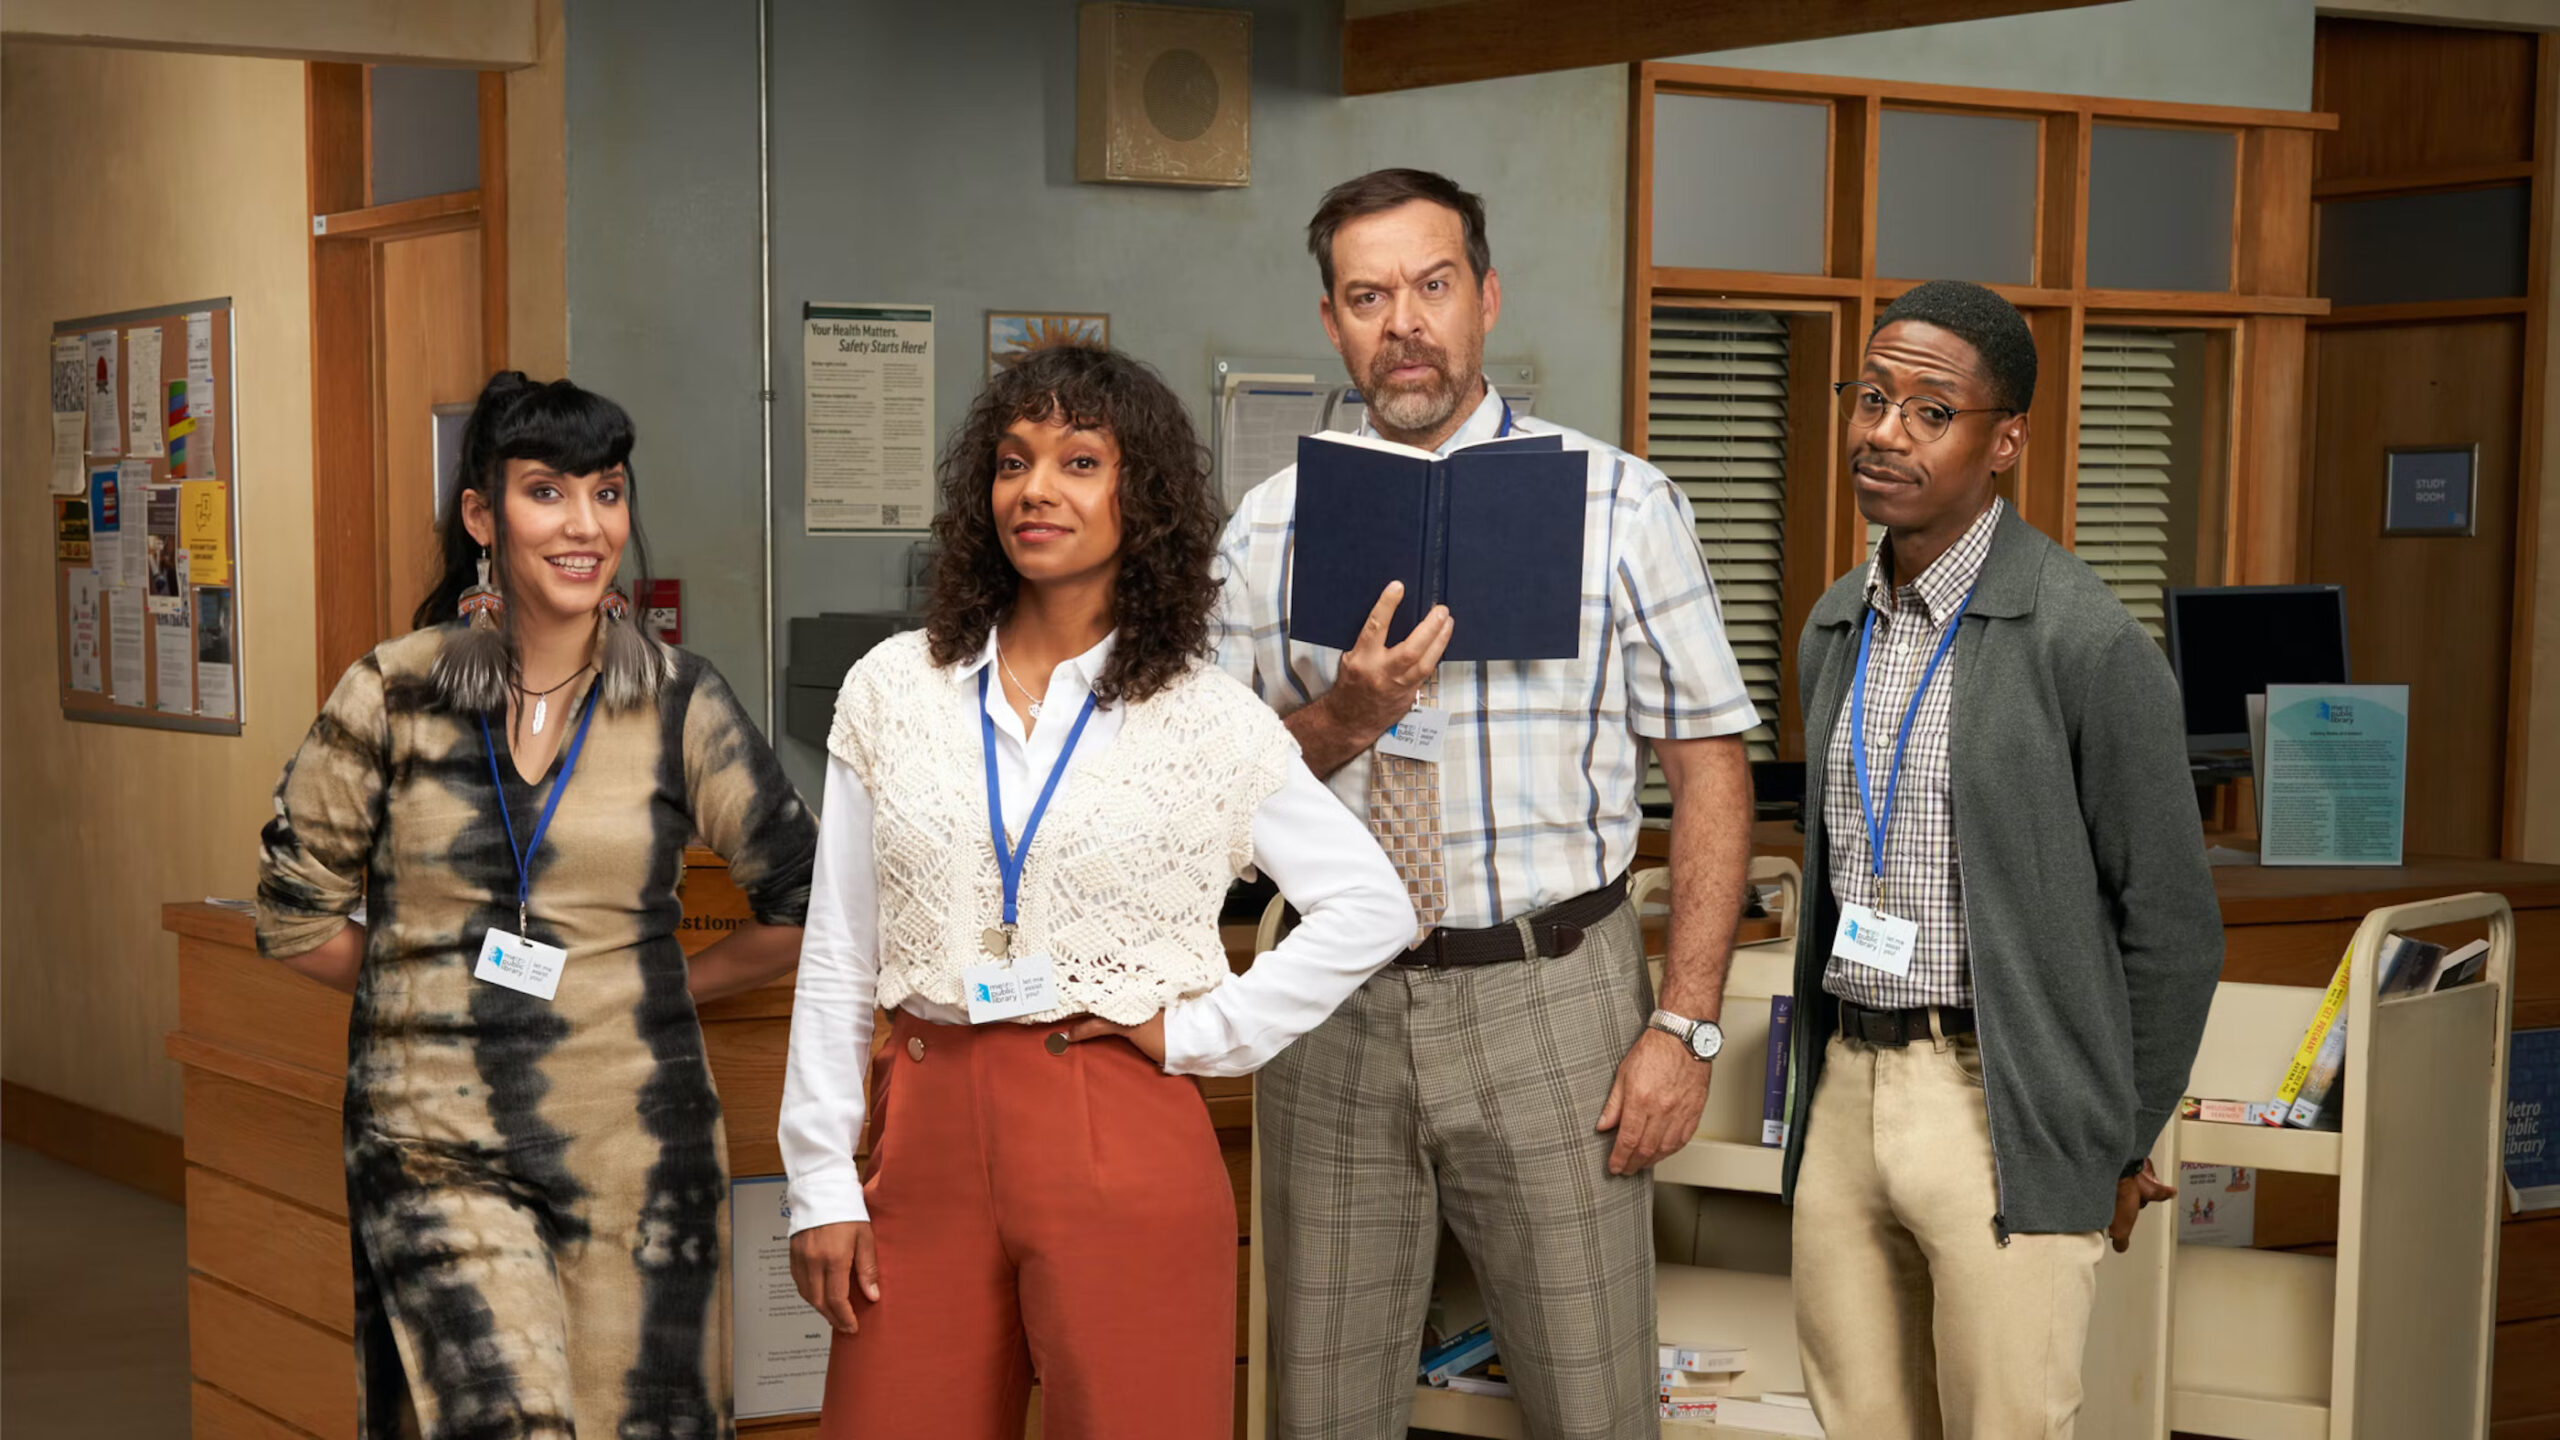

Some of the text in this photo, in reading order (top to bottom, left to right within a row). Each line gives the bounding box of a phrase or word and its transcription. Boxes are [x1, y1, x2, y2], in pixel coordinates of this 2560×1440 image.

[811, 323, 899, 339] Your Health Matters.
[838, 338, 927, 355] Safety Starts Here!
[2416, 478, 2448, 489] STUDY
[2415, 492, 2446, 503] ROOM
[678, 914, 748, 930] stions
[501, 964, 523, 977] library
[991, 987, 1016, 998] public
[992, 993, 1017, 1004] library
[2507, 1117, 2540, 1137] ublic
[2505, 1137, 2546, 1157] ibrary
